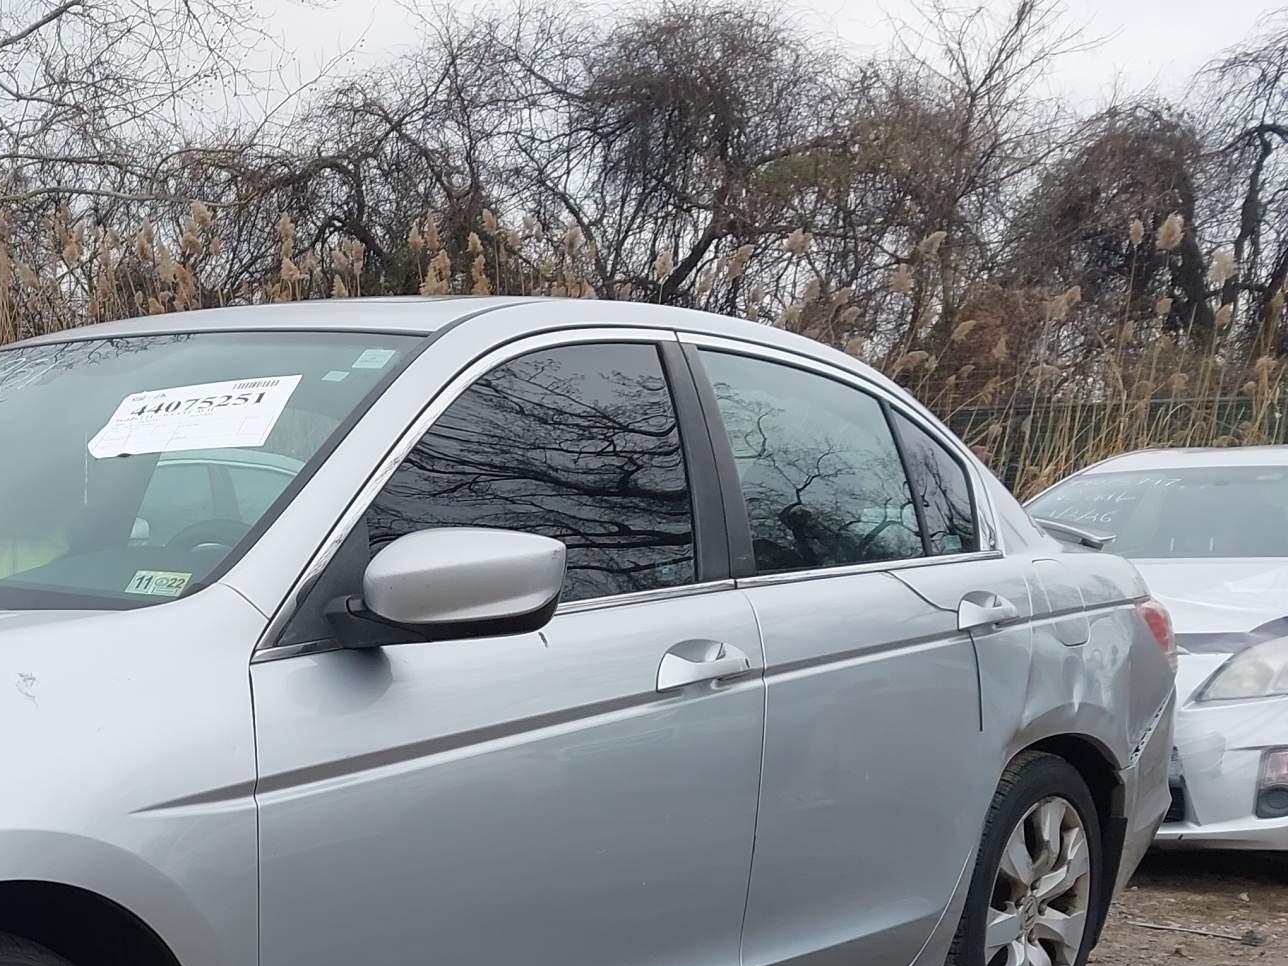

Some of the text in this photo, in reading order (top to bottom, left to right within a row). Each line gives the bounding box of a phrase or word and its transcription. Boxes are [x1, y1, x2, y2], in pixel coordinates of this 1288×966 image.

[130, 391, 267, 417] 44075251
[135, 575, 186, 590] 11 22
